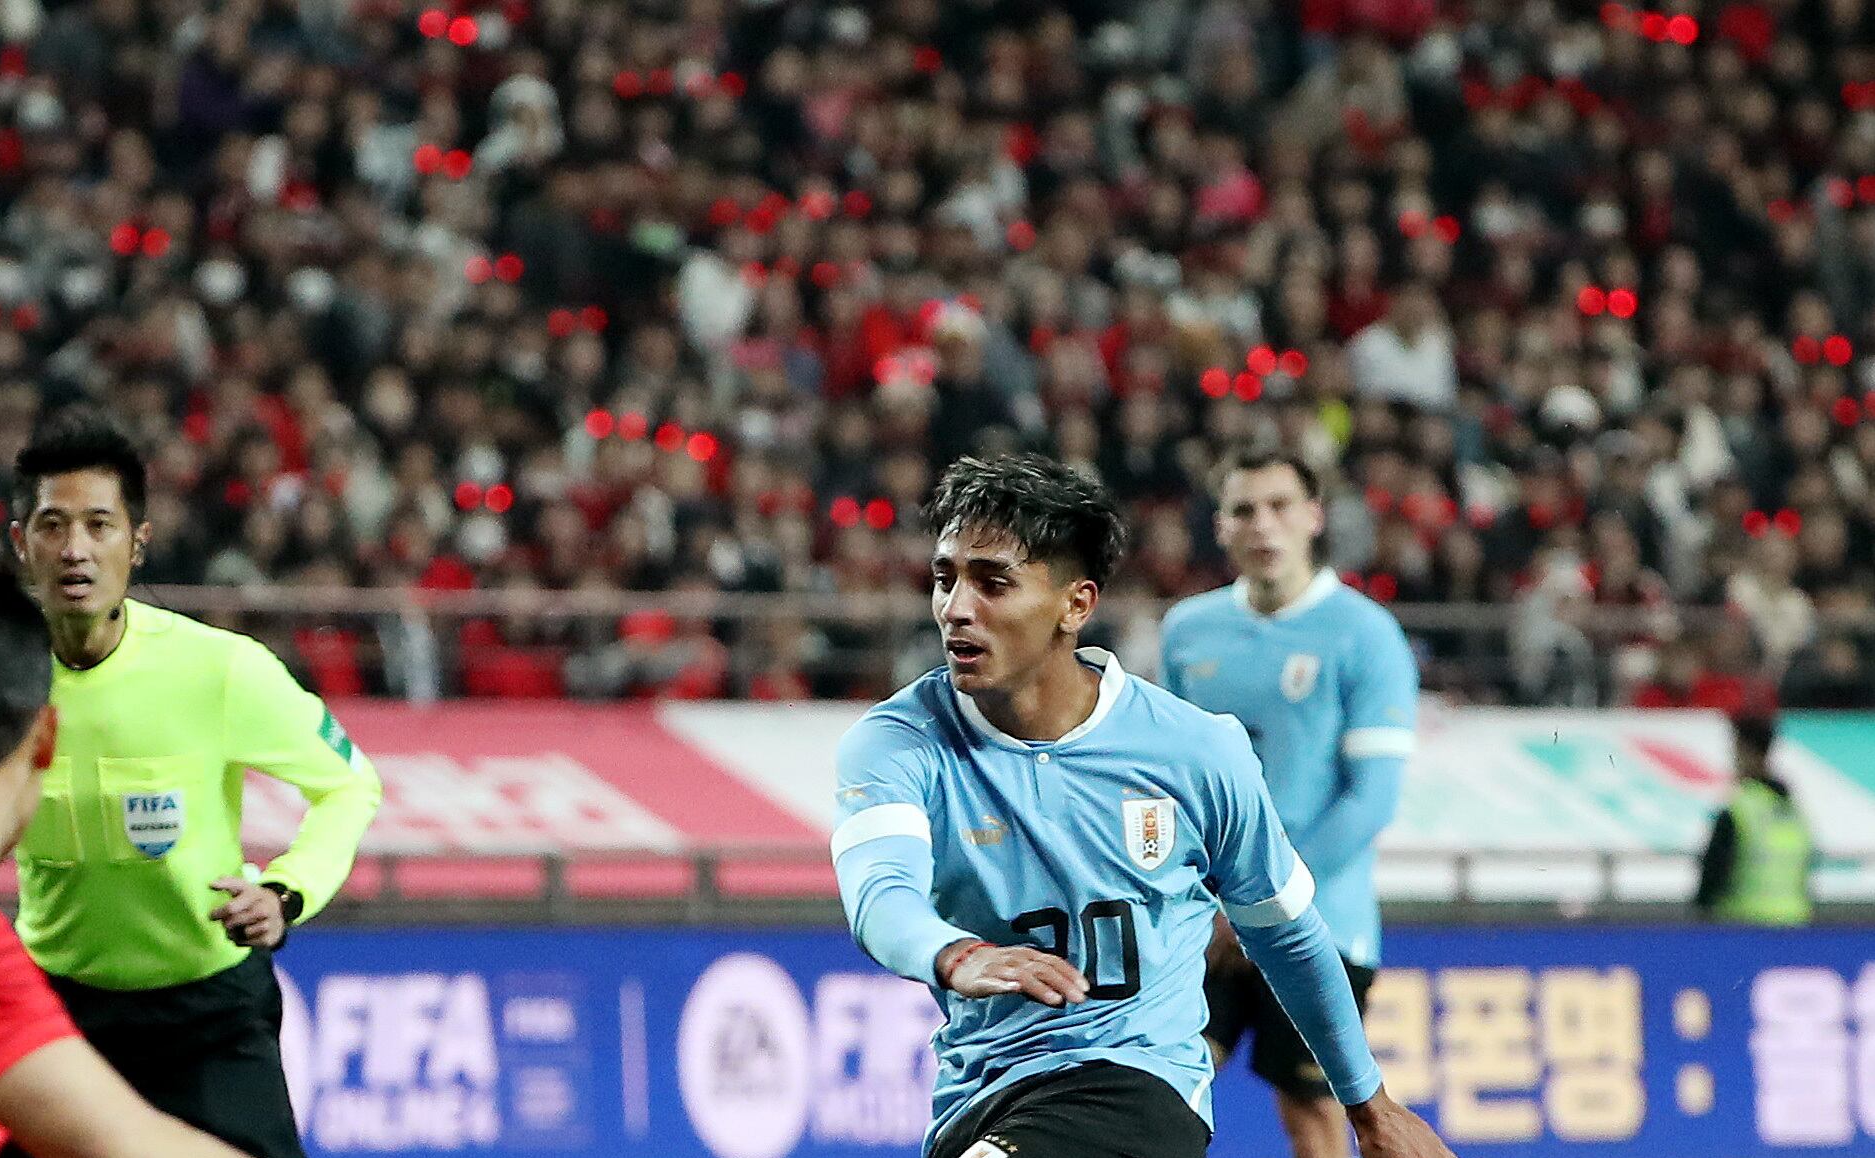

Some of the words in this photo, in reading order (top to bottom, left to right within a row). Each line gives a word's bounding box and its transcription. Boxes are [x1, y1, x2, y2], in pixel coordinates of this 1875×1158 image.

[127, 795, 178, 812] FIFA
[316, 970, 498, 1092] FIFA
[814, 971, 946, 1086] FIF
